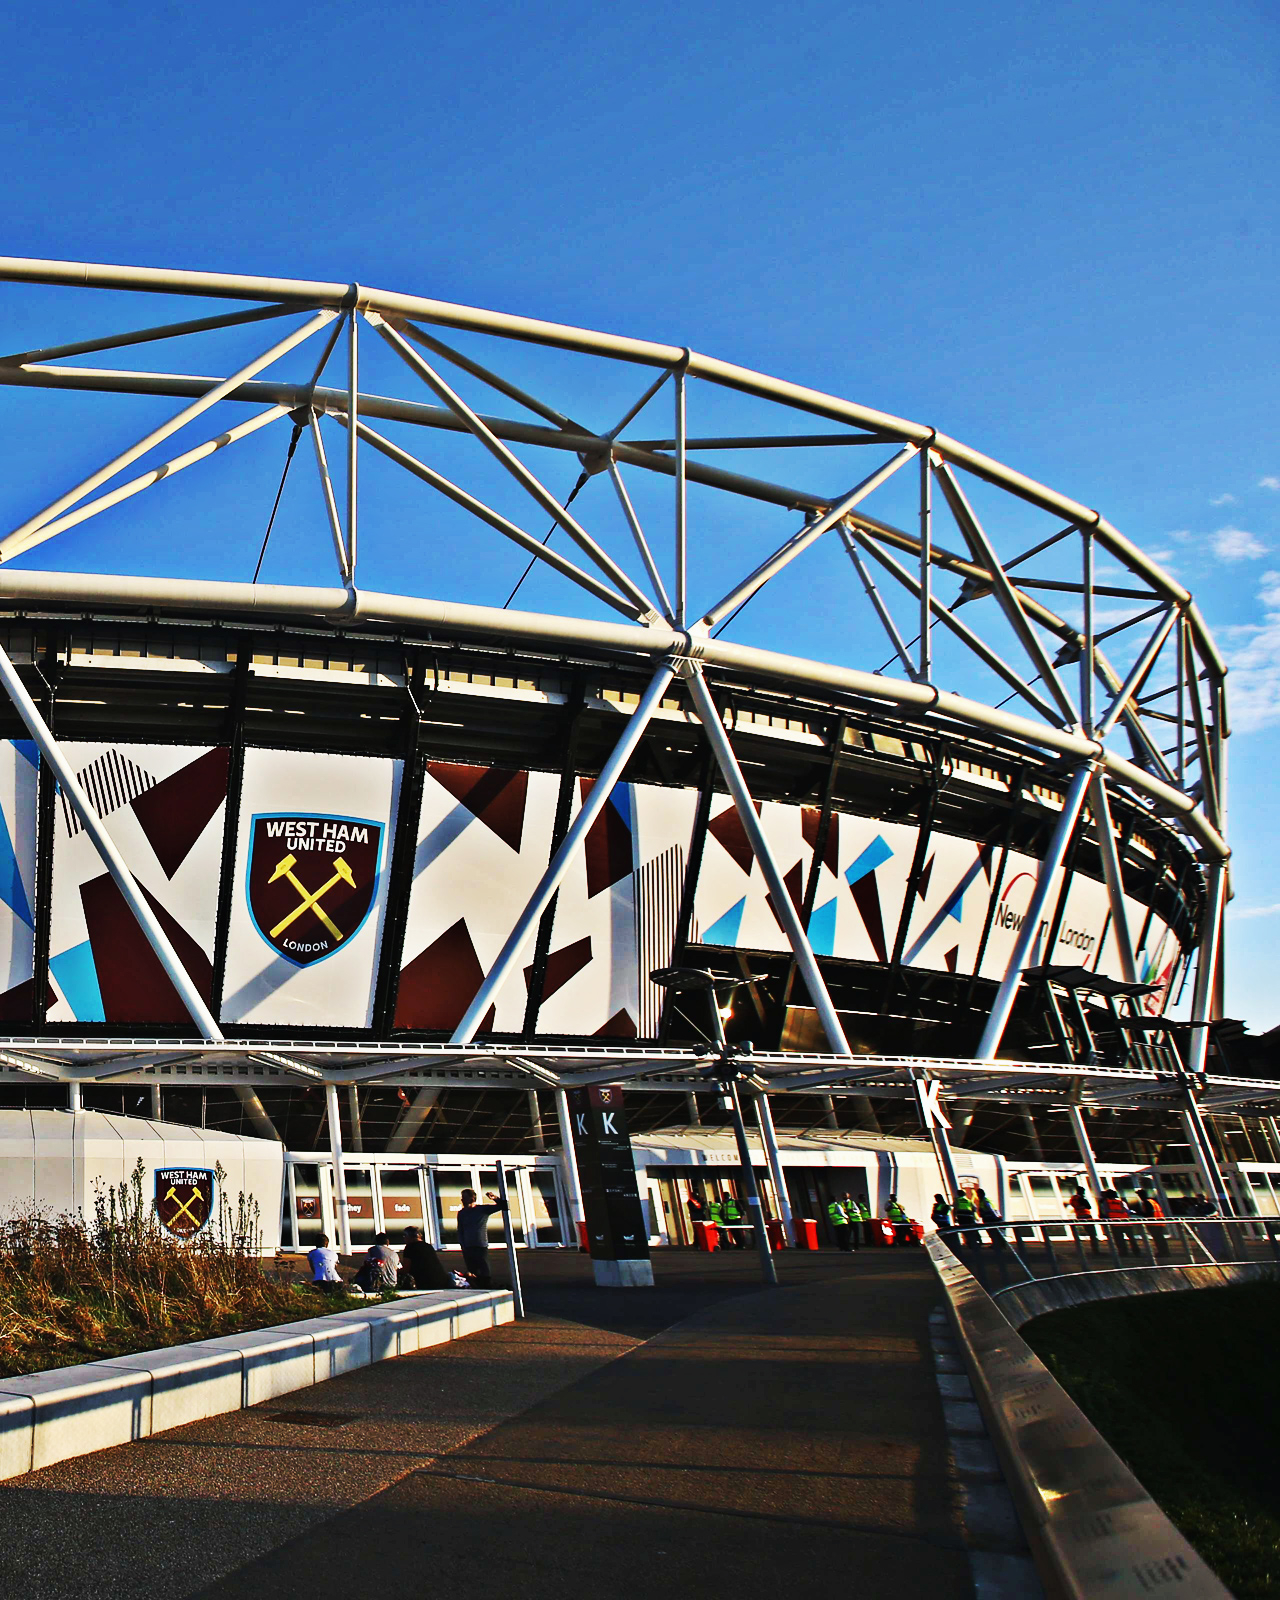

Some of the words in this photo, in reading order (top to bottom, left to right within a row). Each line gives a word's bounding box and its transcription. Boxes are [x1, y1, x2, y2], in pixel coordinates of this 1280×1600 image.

[266, 821, 319, 837] WEST
[323, 823, 369, 844] HAM
[287, 838, 346, 853] UNITED
[283, 938, 328, 952] LONDON
[1059, 920, 1095, 953] London
[916, 1079, 953, 1128] K
[576, 1113, 588, 1135] K
[602, 1112, 618, 1134] K
[701, 1153, 739, 1161] WELCOM
[161, 1171, 184, 1180] WEST
[186, 1171, 207, 1180] HAM
[394, 1203, 411, 1212] fade
